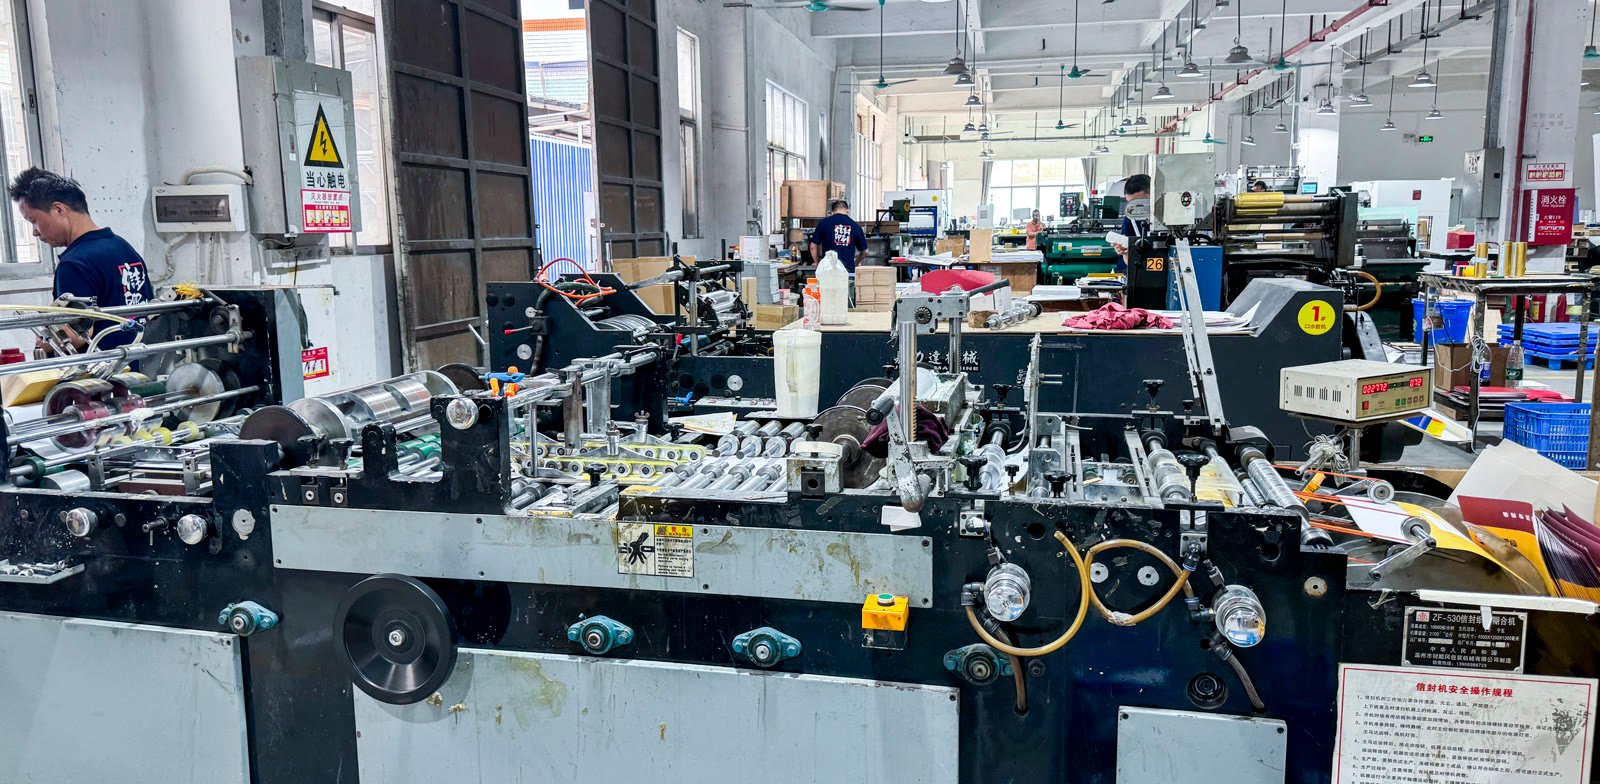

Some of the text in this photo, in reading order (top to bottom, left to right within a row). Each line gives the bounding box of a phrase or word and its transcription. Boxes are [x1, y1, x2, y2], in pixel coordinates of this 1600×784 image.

[306, 171, 345, 188] 当心触电
[1541, 195, 1567, 205] 消火栓
[1147, 258, 1163, 270] 26
[1416, 682, 1513, 697] 信封机安全操作规程
